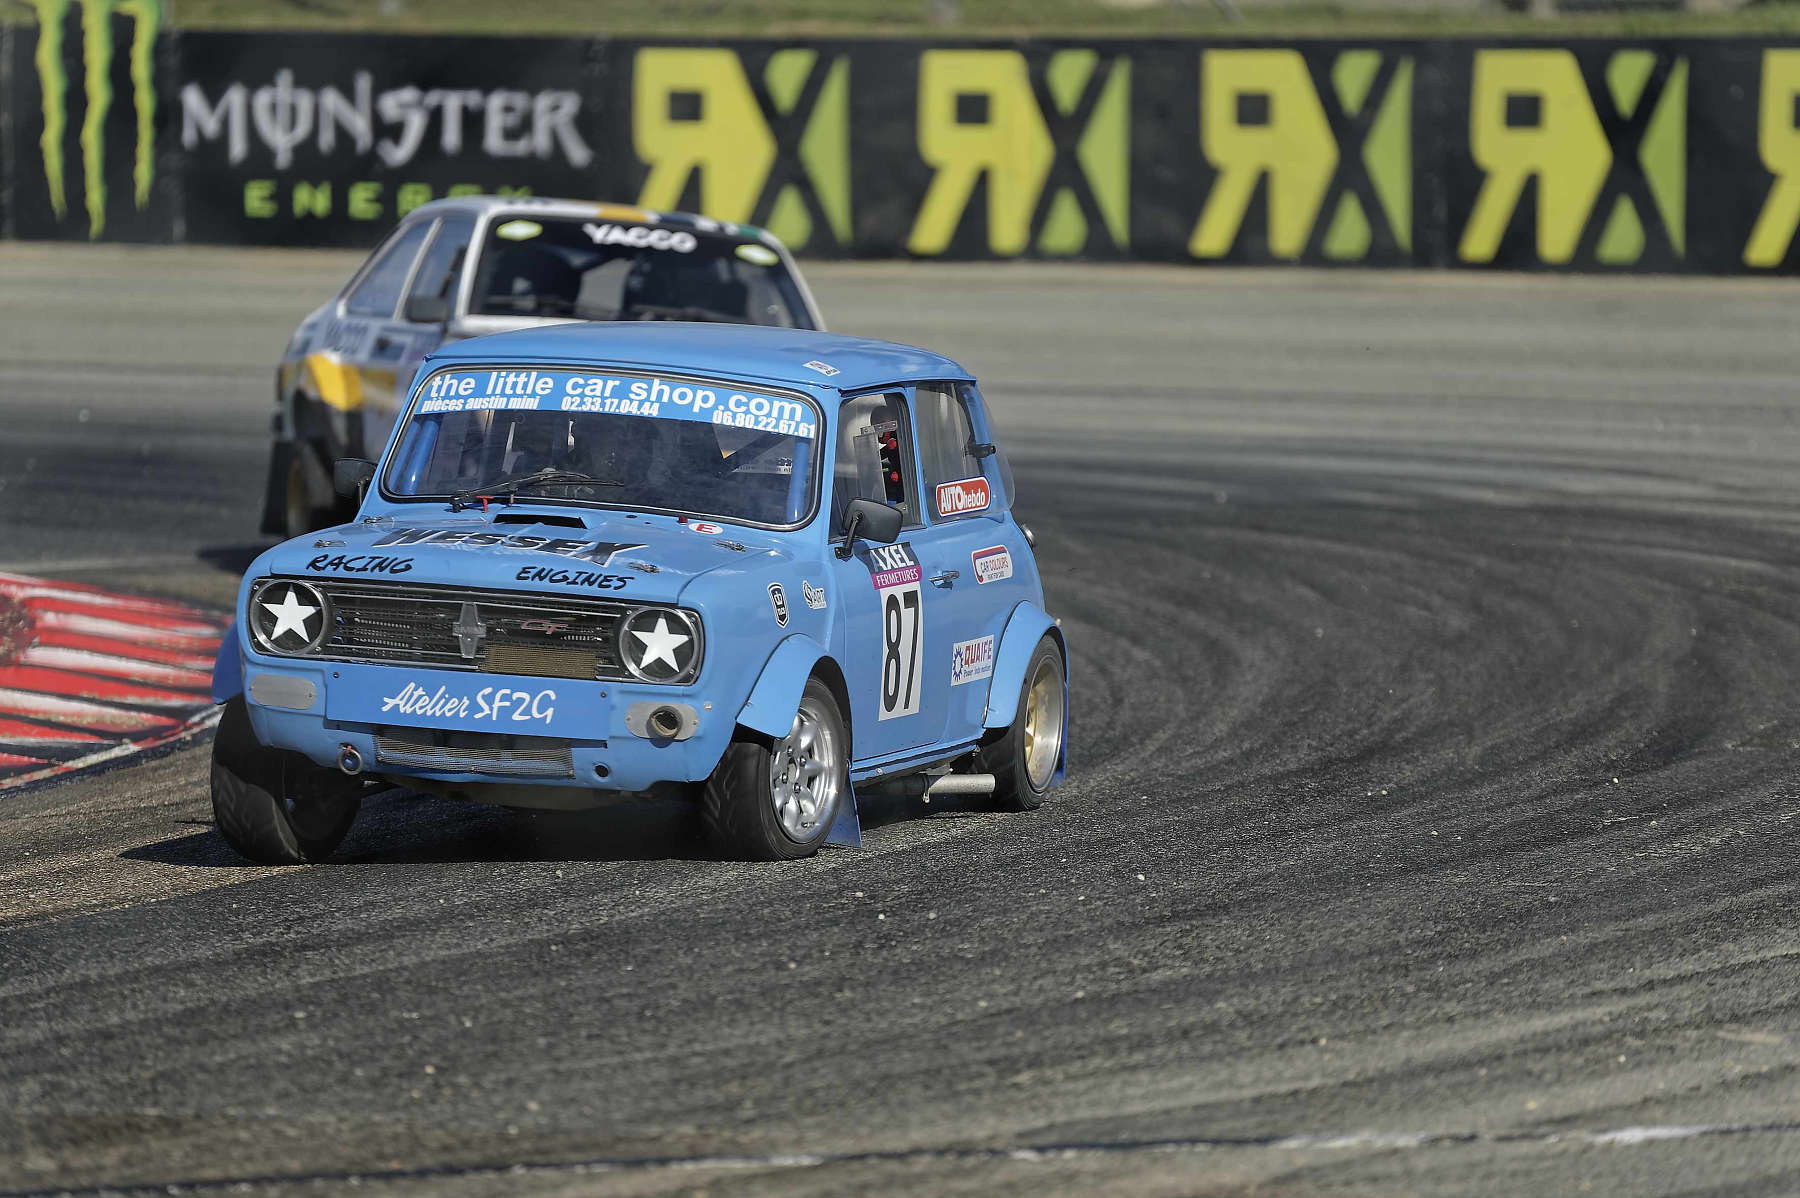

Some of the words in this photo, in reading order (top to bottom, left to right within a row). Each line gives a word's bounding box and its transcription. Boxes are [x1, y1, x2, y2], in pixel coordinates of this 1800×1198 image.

[180, 67, 594, 170] MONSTER
[581, 221, 698, 254] YACCO
[430, 374, 475, 398] the
[485, 371, 554, 395] little
[565, 377, 621, 397] car
[465, 395, 508, 409] austin
[507, 395, 541, 410] mini
[561, 396, 660, 416] 02.33.17.04.44
[696, 523, 717, 534] E
[372, 527, 649, 568] WESSEX
[870, 543, 915, 573] AXEL
[305, 553, 414, 576] RACING
[514, 566, 635, 591] ENGINES
[876, 568, 919, 587] FERMETURES
[883, 589, 920, 713] 87
[964, 639, 993, 667] QUAIFE
[381, 681, 470, 718] Atelier
[473, 687, 556, 724] SF2G
